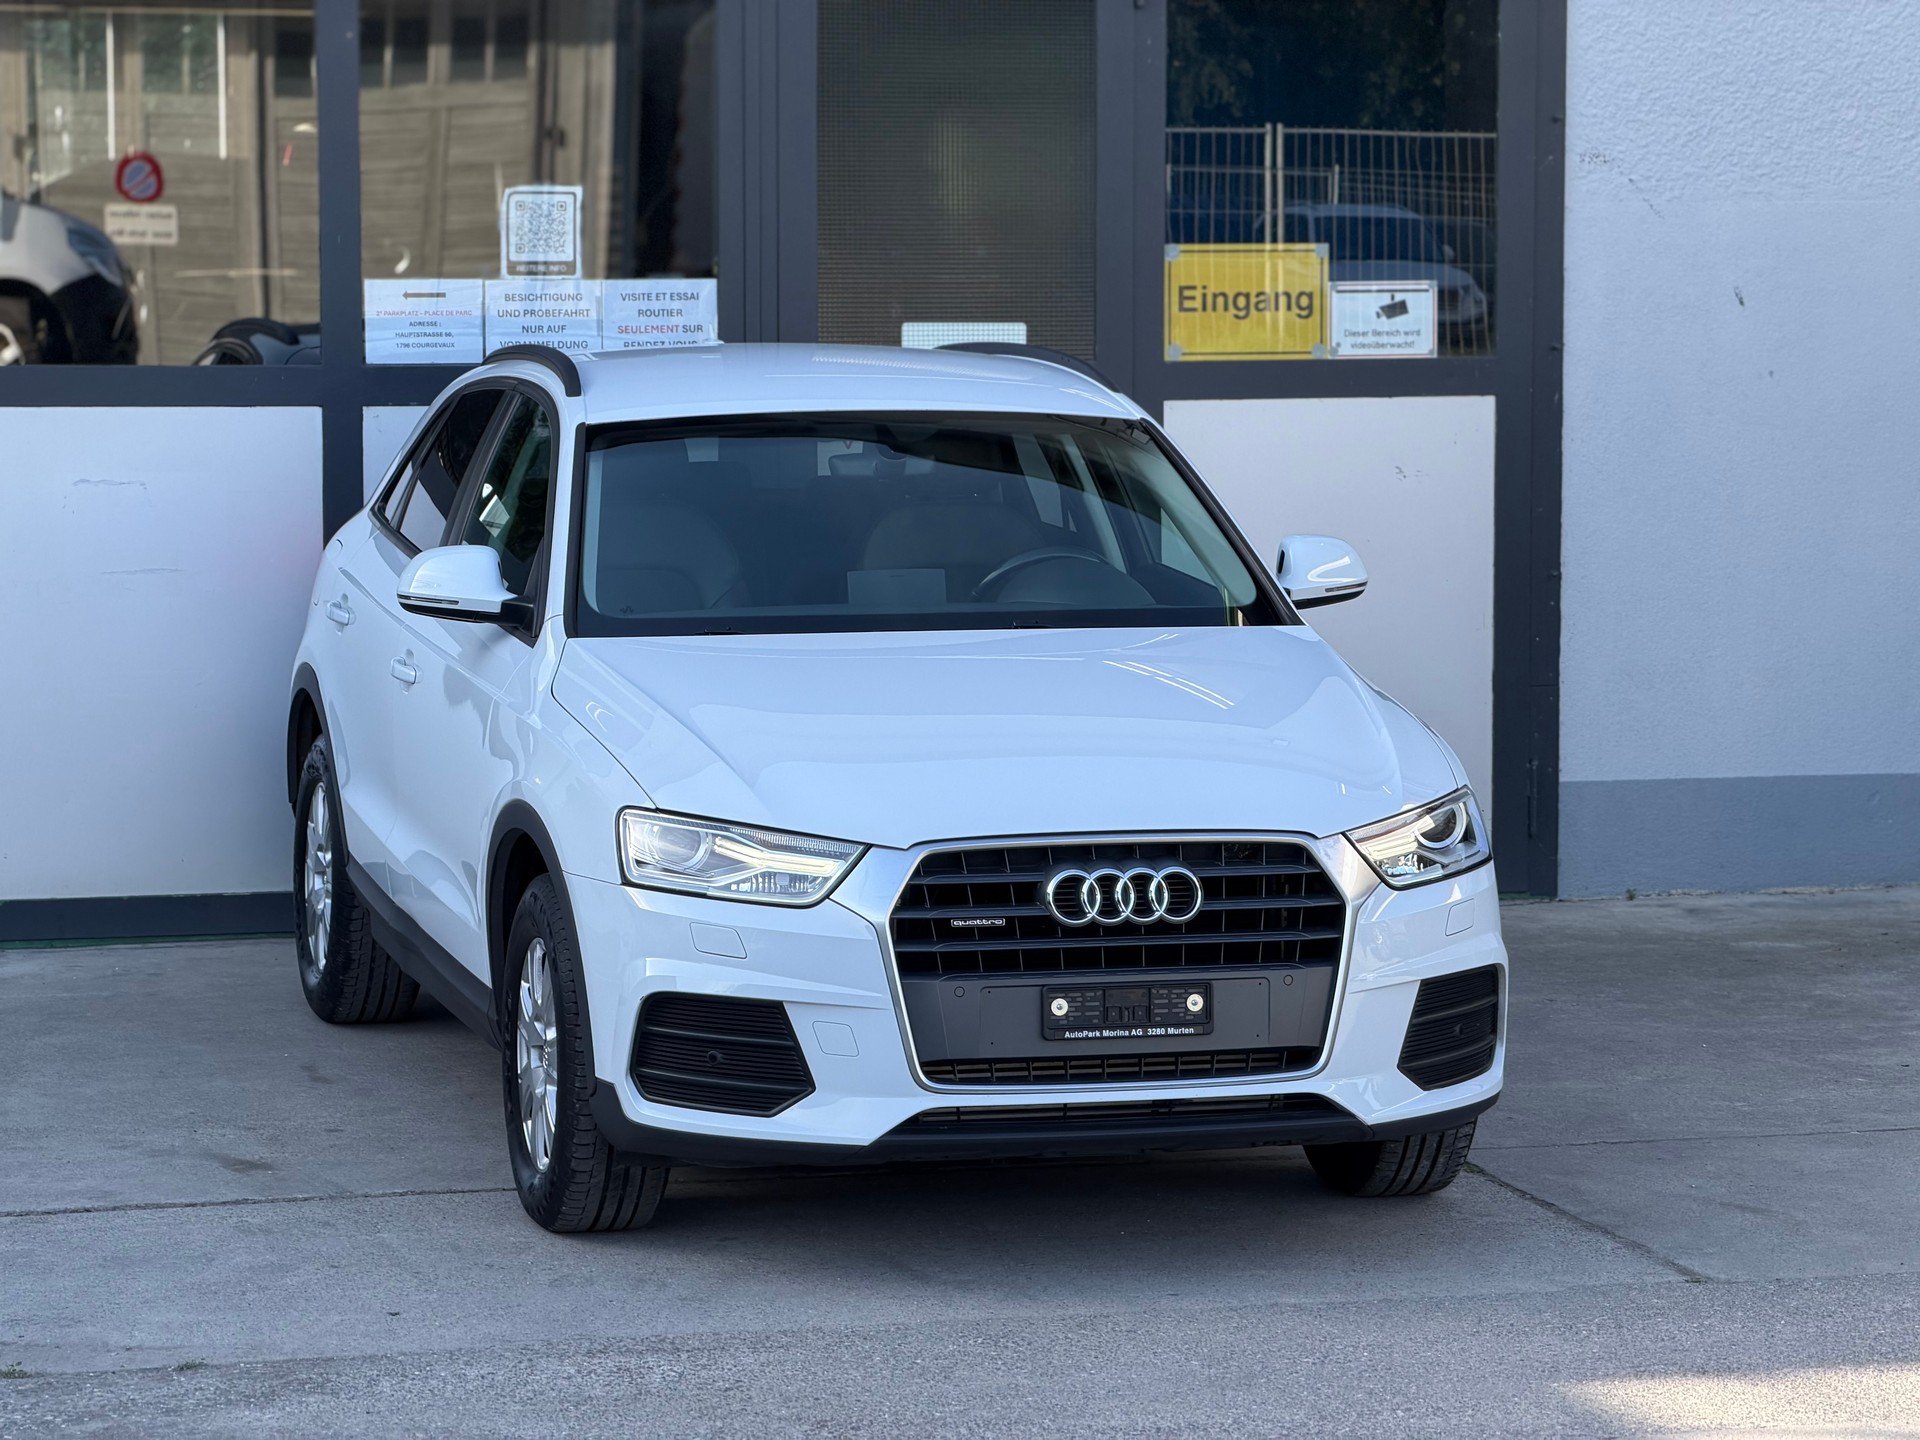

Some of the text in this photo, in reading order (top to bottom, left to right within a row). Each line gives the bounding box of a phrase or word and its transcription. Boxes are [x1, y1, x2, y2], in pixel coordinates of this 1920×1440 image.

[504, 293, 584, 302] BESICHTIGUNG
[620, 292, 700, 302] VISITE ET ESSAI
[1177, 284, 1314, 320] Eingang
[497, 308, 591, 318] UND PROBEFAHRT
[638, 308, 684, 318] ROUTIER
[522, 324, 567, 334] NUR AUF
[617, 324, 704, 334] SEULEMENT SUR
[1344, 329, 1370, 337] Dieser
[1372, 328, 1401, 337] Bereich
[1064, 1029, 1101, 1039] AutoPark
[1102, 1029, 1129, 1037] Morina
